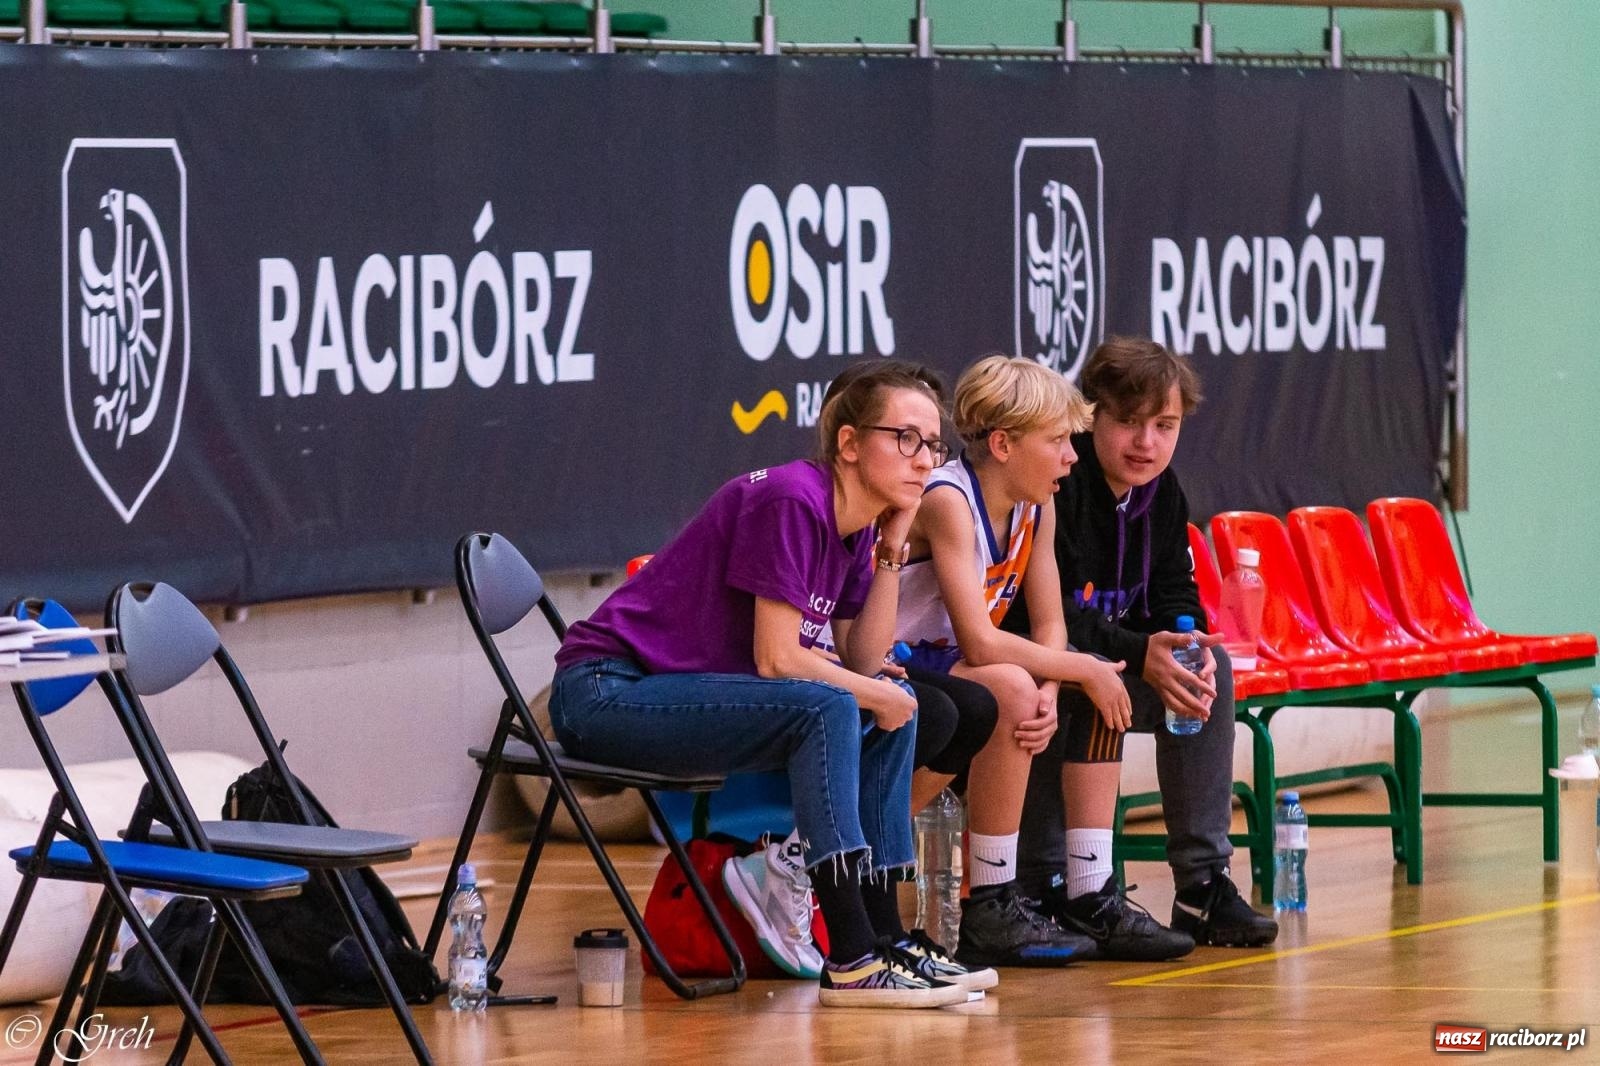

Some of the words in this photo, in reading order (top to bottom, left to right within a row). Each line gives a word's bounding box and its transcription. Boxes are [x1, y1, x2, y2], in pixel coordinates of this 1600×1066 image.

[259, 200, 595, 398] RACIBÓRZ
[729, 183, 896, 361] OSiR
[1151, 193, 1387, 356] RACIBÓRZ
[796, 380, 833, 427] RA
